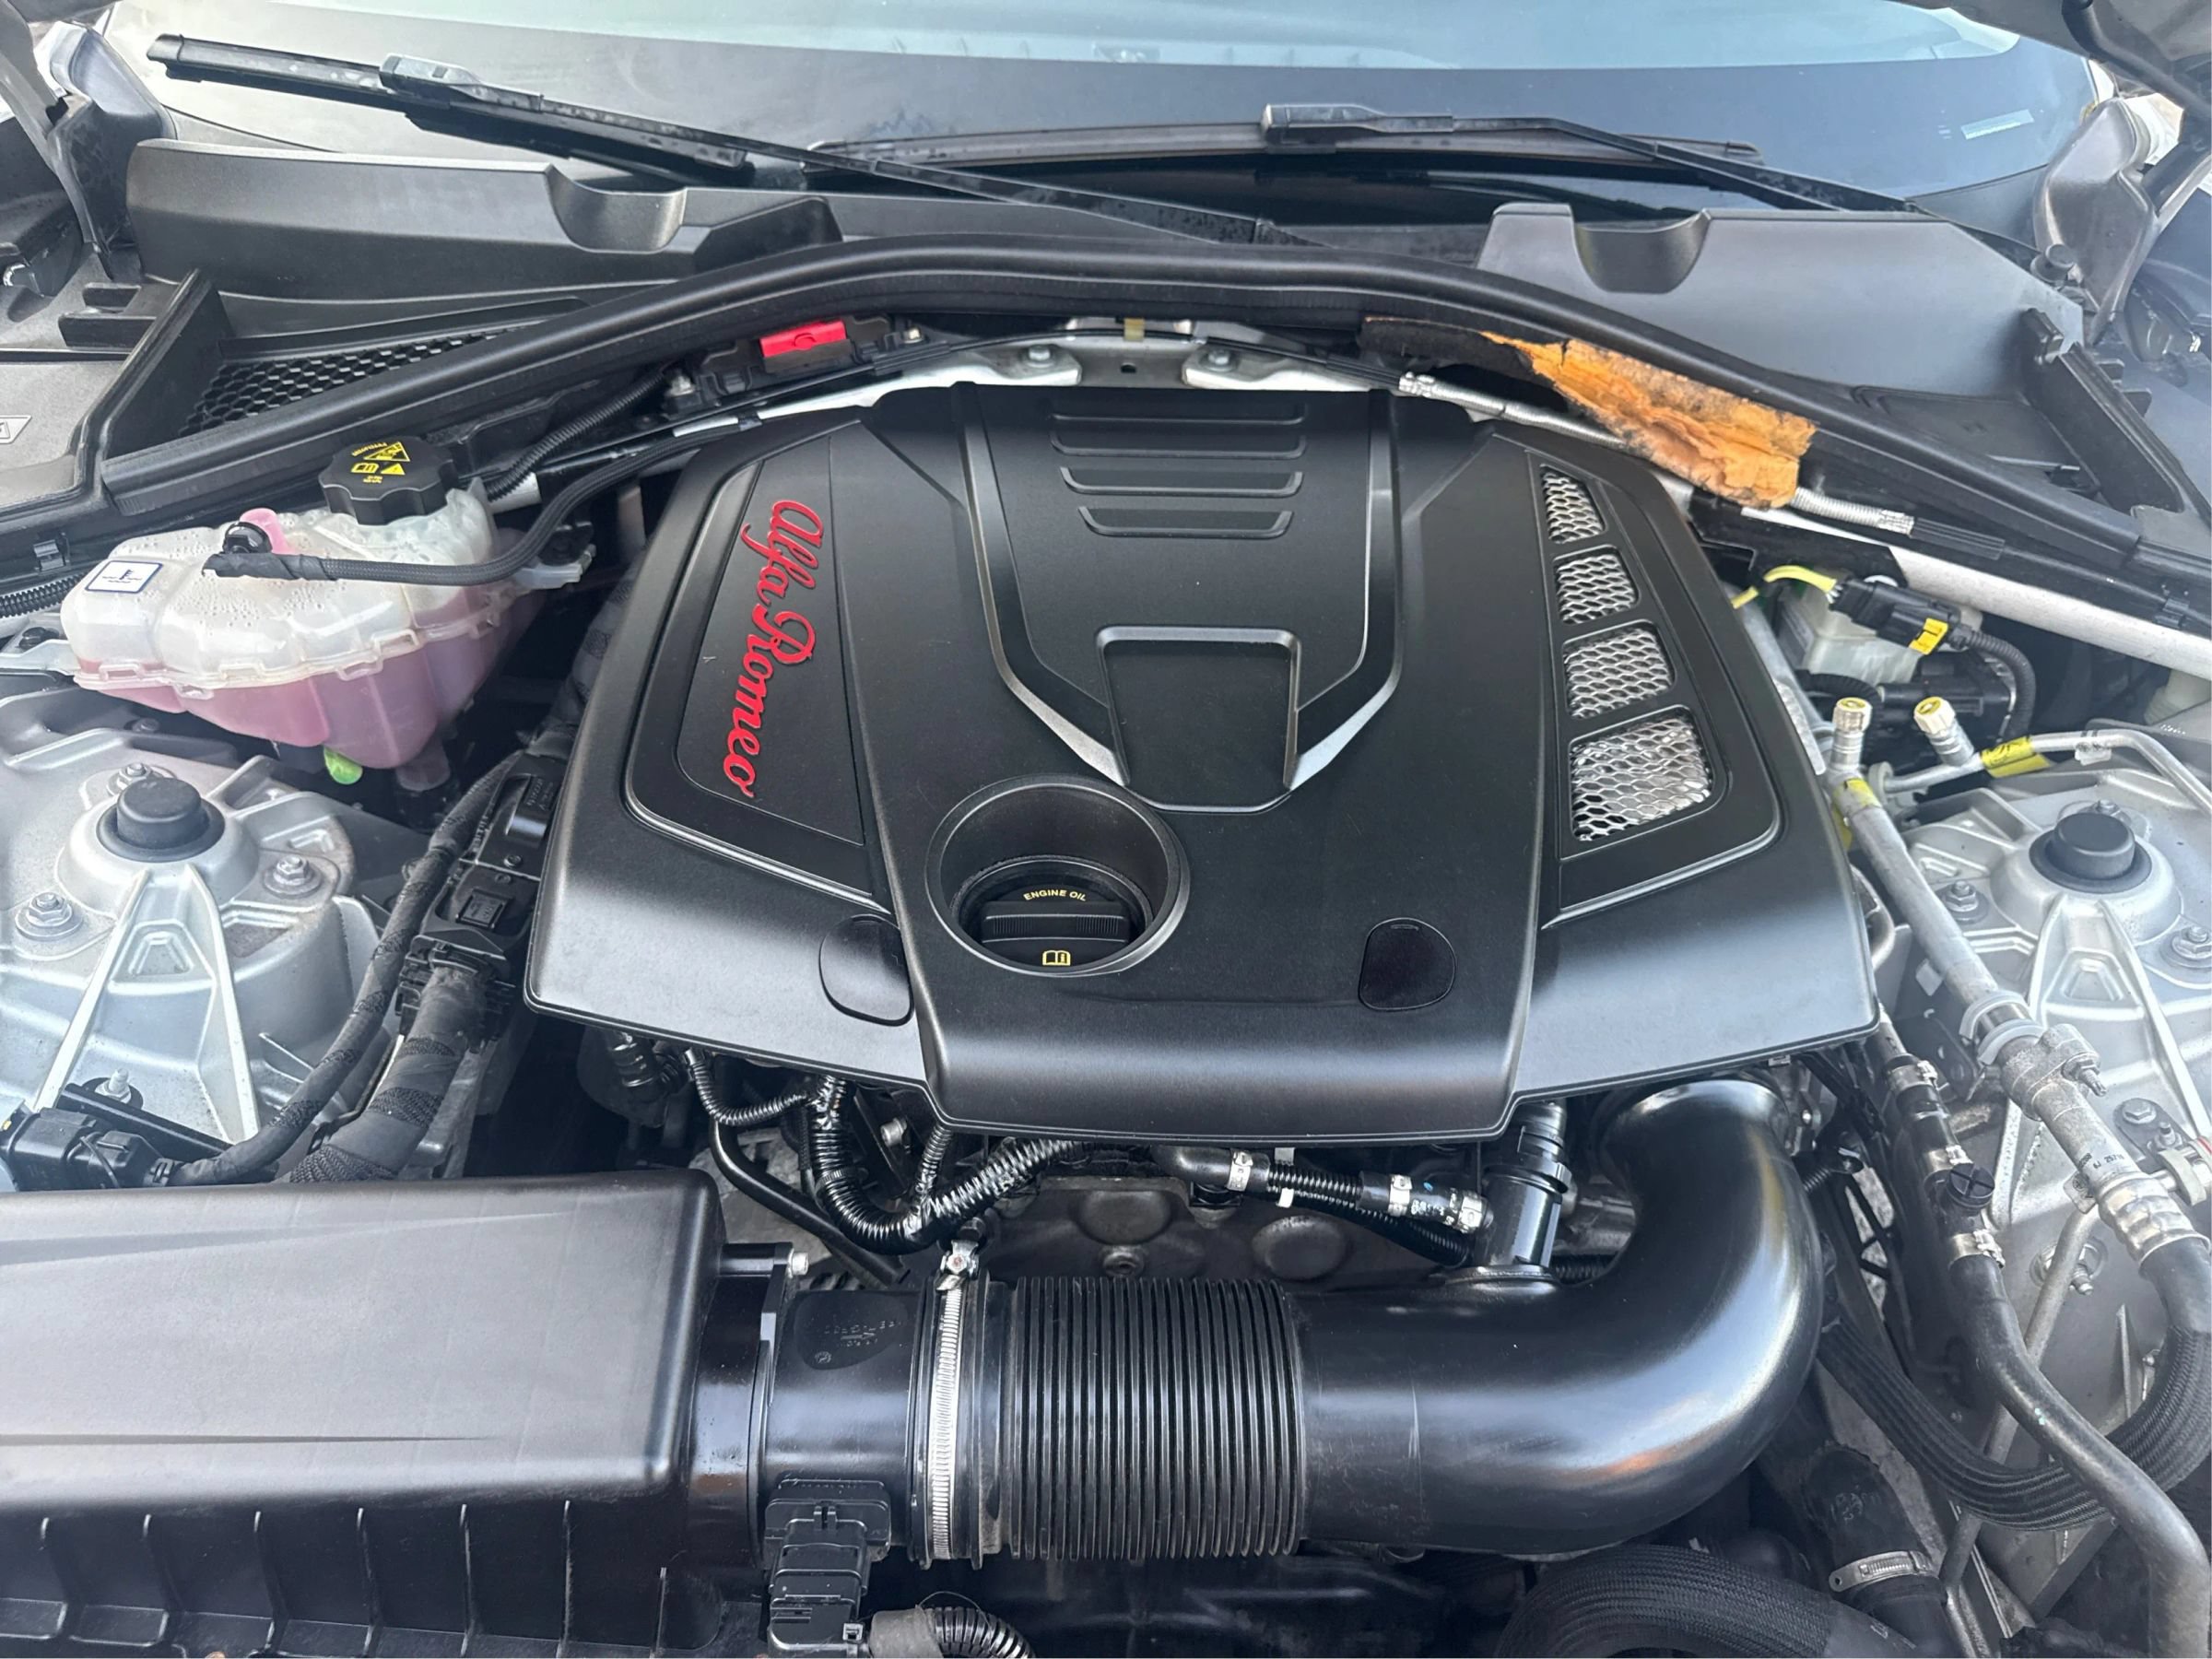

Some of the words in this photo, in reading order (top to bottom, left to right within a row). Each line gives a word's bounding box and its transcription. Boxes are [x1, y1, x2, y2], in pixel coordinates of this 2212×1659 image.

[740, 500, 824, 605] Alfa
[723, 603, 816, 797] Romeo
[1023, 889, 1067, 900] ENGINE
[1069, 891, 1087, 901] OIL
